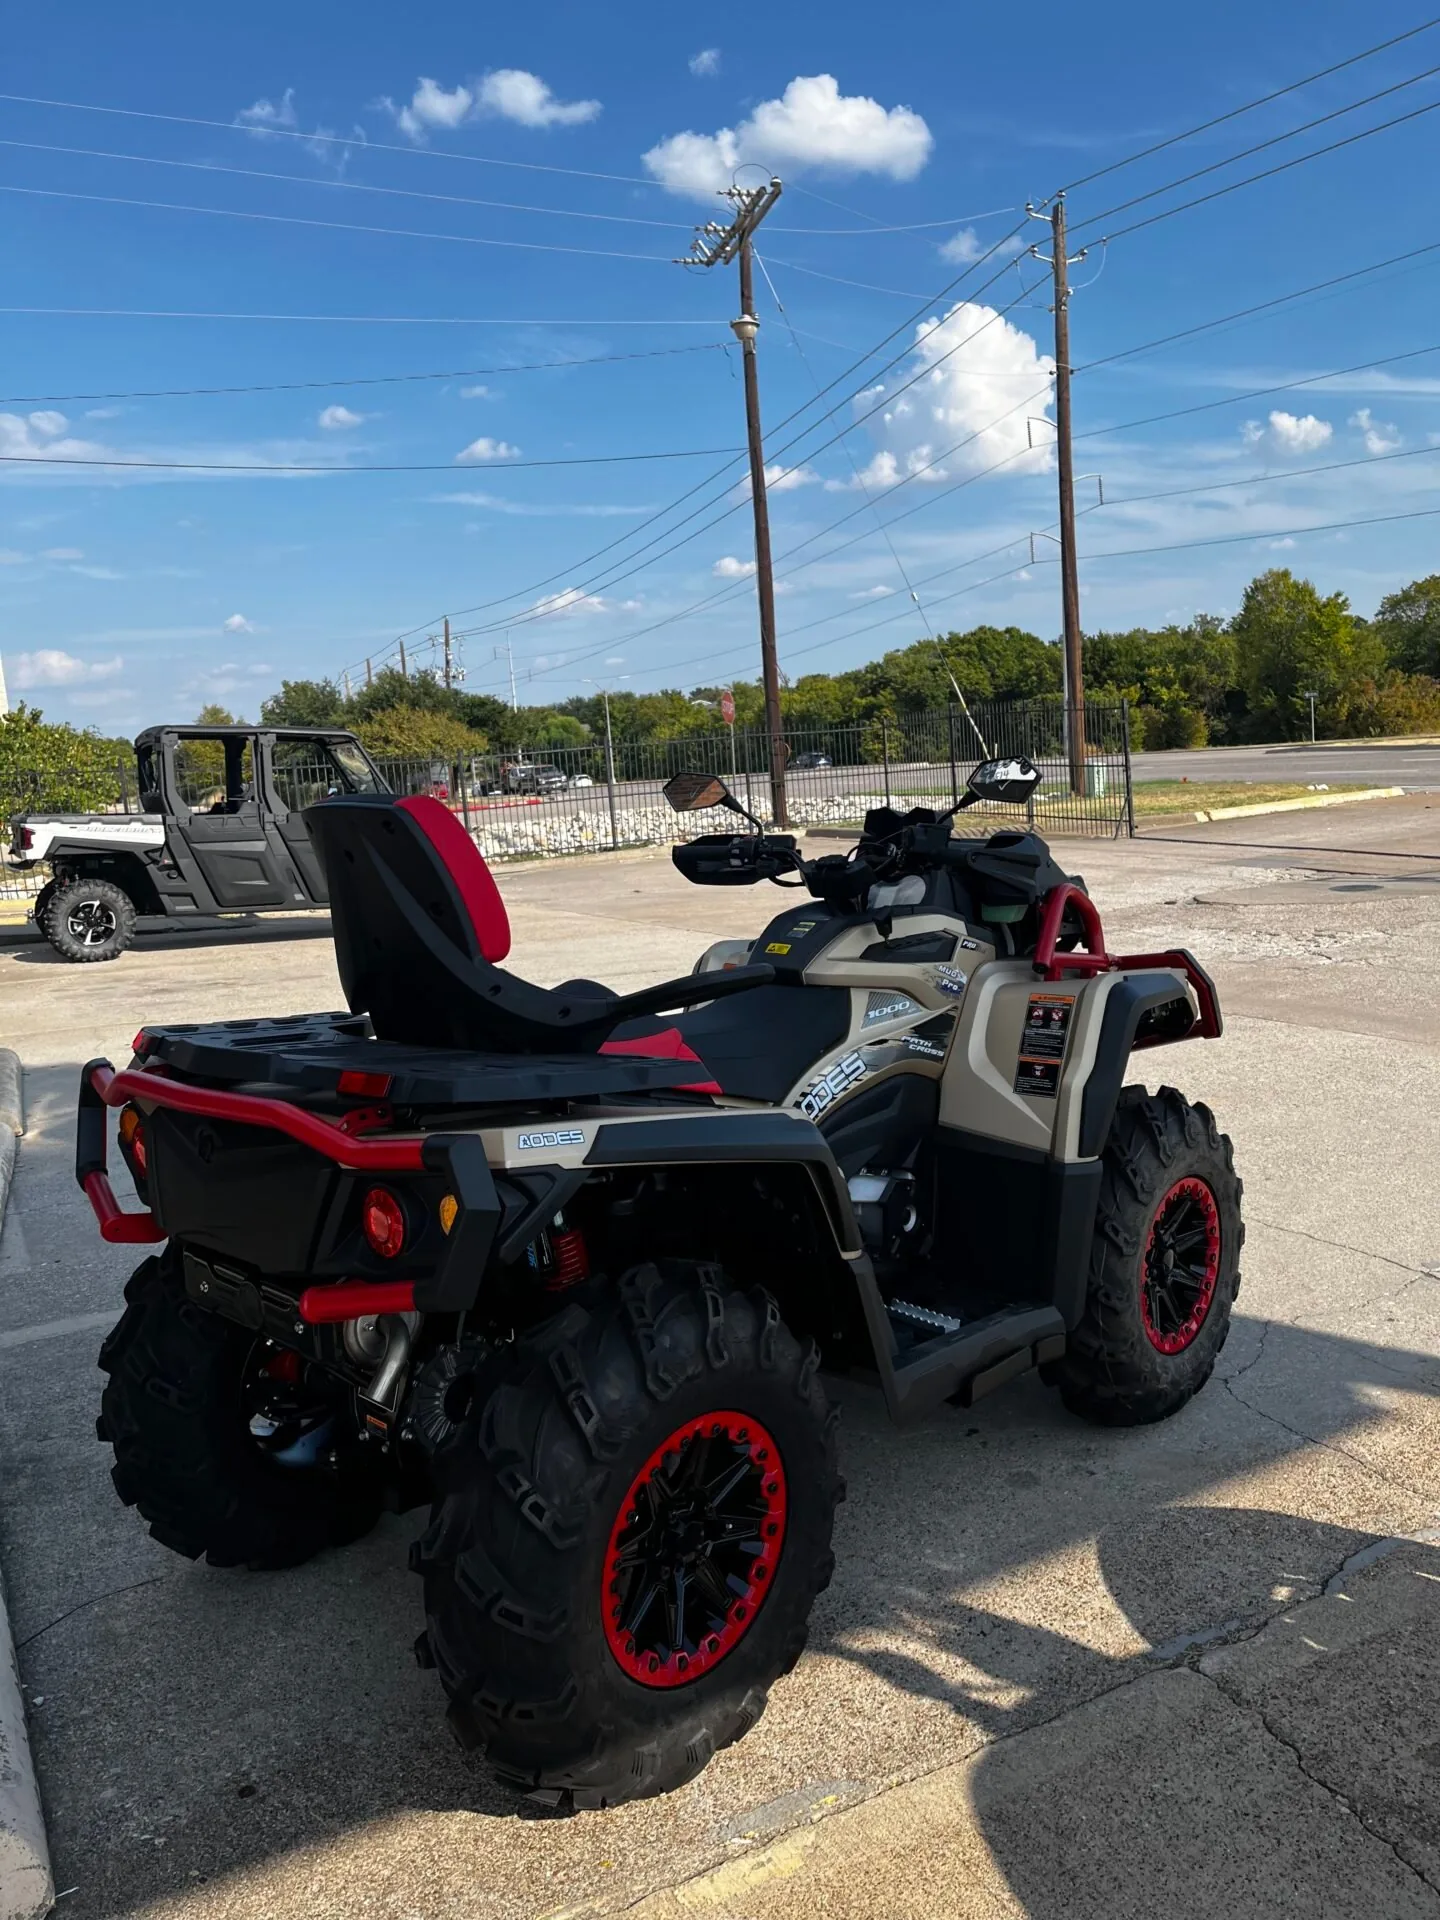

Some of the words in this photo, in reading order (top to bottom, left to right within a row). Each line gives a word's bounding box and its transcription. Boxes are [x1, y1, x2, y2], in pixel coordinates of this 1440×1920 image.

[962, 940, 977, 949] PRO
[941, 978, 959, 991] Pro
[868, 1000, 910, 1019] 1000
[901, 1035, 932, 1047] PATH
[908, 1044, 945, 1057] CROSS
[519, 1129, 585, 1149] AODES
